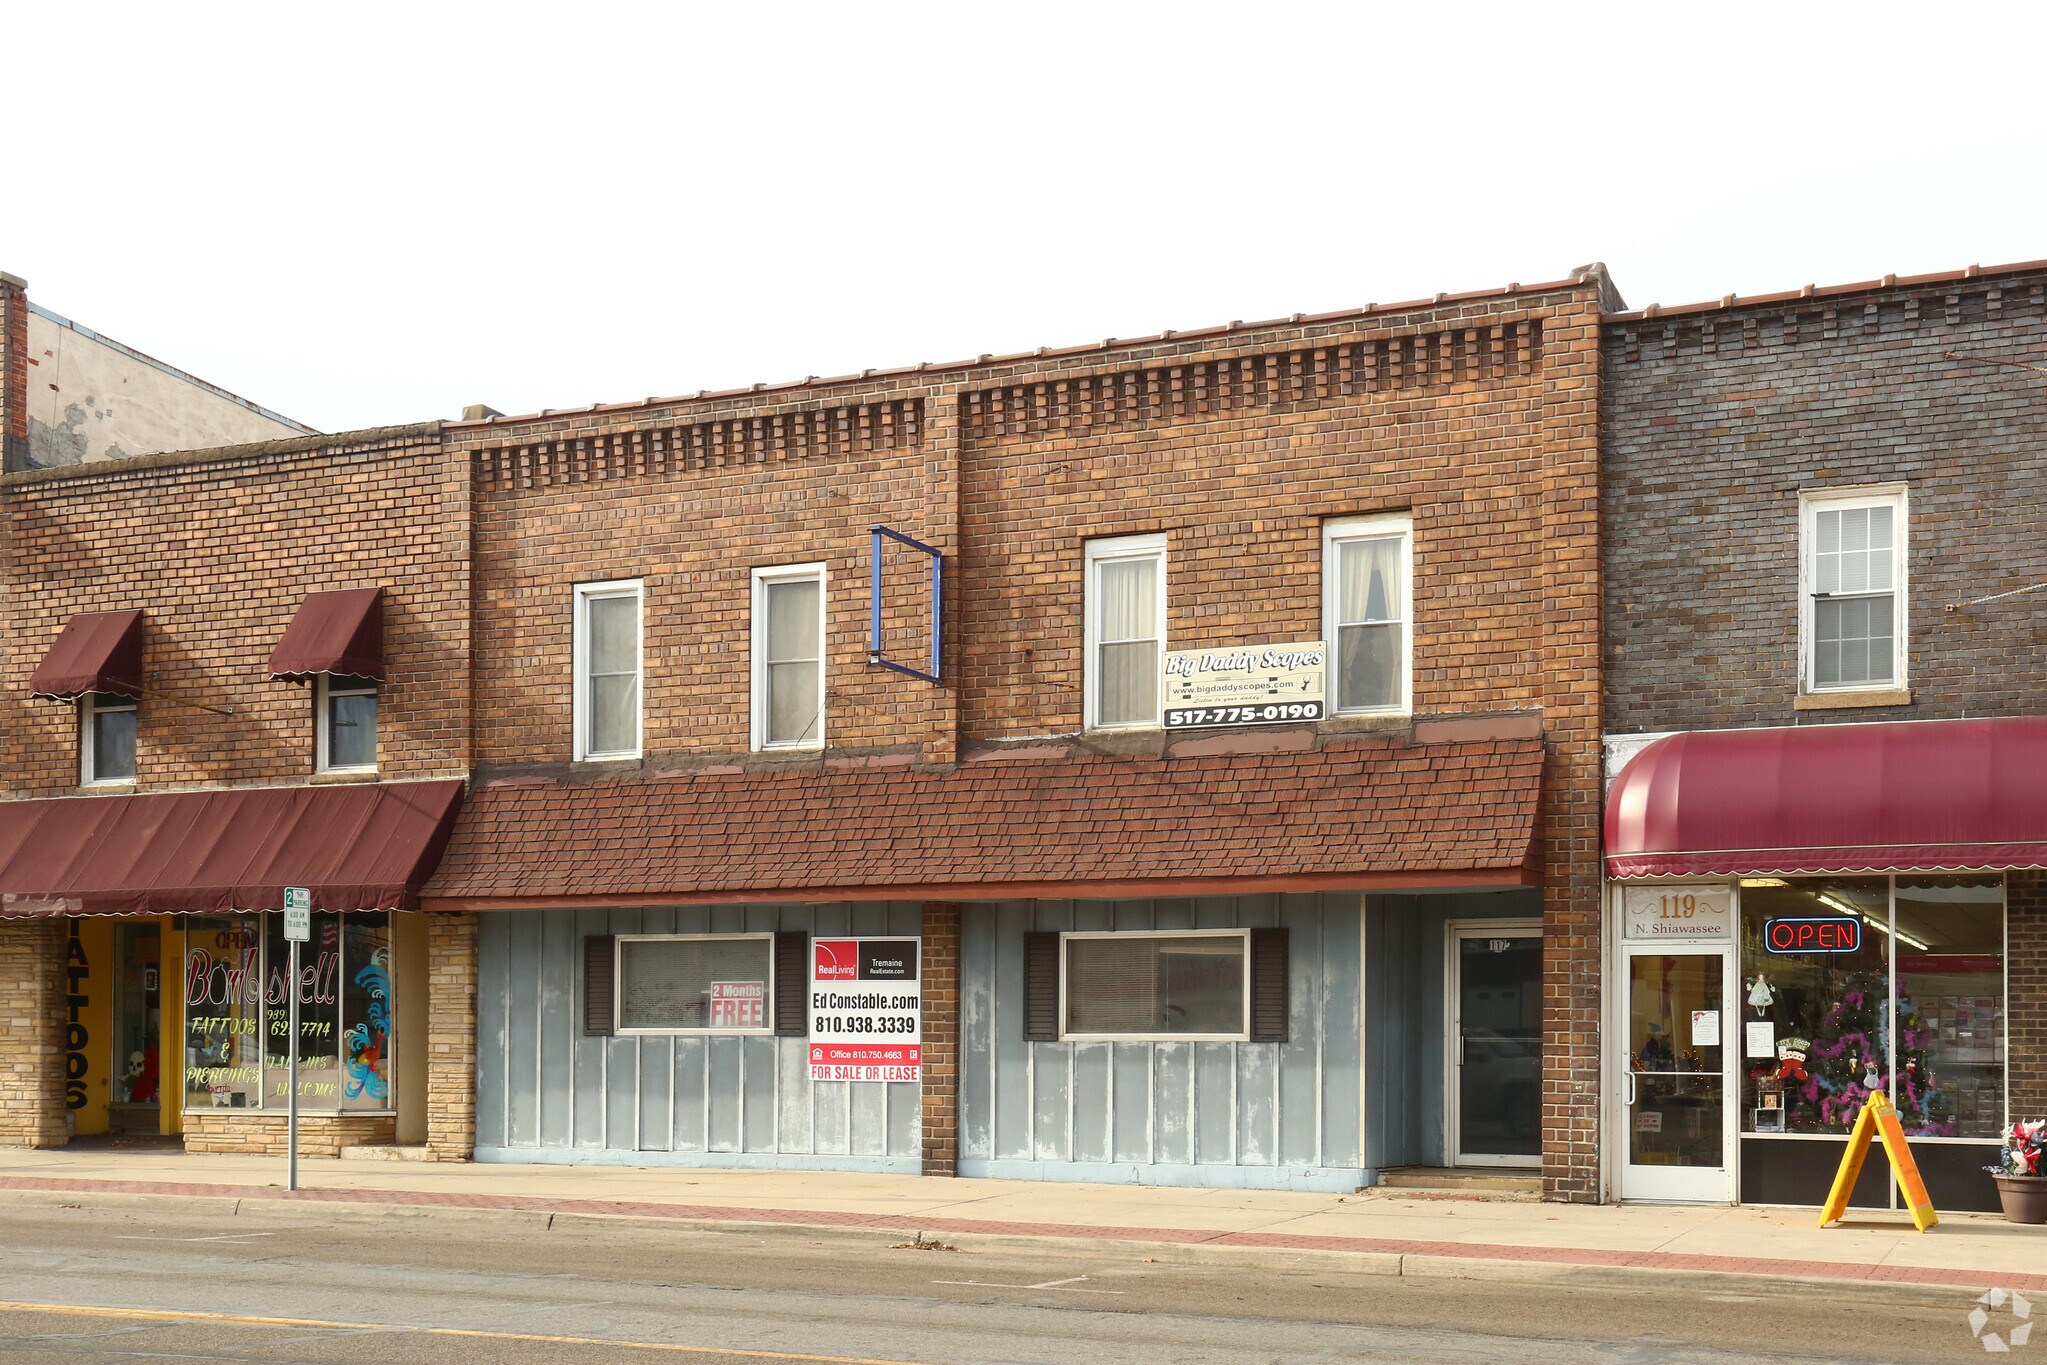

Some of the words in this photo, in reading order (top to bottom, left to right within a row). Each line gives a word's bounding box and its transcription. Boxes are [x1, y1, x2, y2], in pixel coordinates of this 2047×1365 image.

[1166, 655, 1198, 677] Big
[1199, 651, 1259, 673] Daddy
[1260, 649, 1324, 671] Scopes
[1173, 681, 1293, 694] www.bigdaddyscopes.com
[1169, 704, 1318, 725] 517-775-0190
[286, 891, 293, 905] 2
[1660, 894, 1696, 918] 119
[1635, 924, 1648, 933] N.
[1652, 923, 1721, 934] Shiawassee
[1772, 924, 1854, 949] OPEN
[872, 959, 903, 967] Tremaine
[713, 985, 721, 996] 2
[723, 985, 762, 997] Months
[813, 993, 827, 1009] Ed
[830, 993, 918, 1009] Constable.com
[67, 916, 90, 1110] TATTOOS
[711, 1000, 762, 1026] FREE
[191, 1017, 257, 1035] TATTOOS
[815, 1017, 915, 1033] 810.938.3339
[220, 1039, 230, 1062] &
[830, 1050, 851, 1058] Office
[852, 1050, 902, 1059] 810.750.4663
[264, 1055, 328, 1070] WAL-INS
[186, 1067, 259, 1085] PIERCINGS
[811, 1066, 831, 1079] FOR
[835, 1066, 861, 1080] SALE
[865, 1067, 879, 1080] OR
[883, 1067, 917, 1080] LEASE
[276, 1082, 337, 1096] WLCOME
